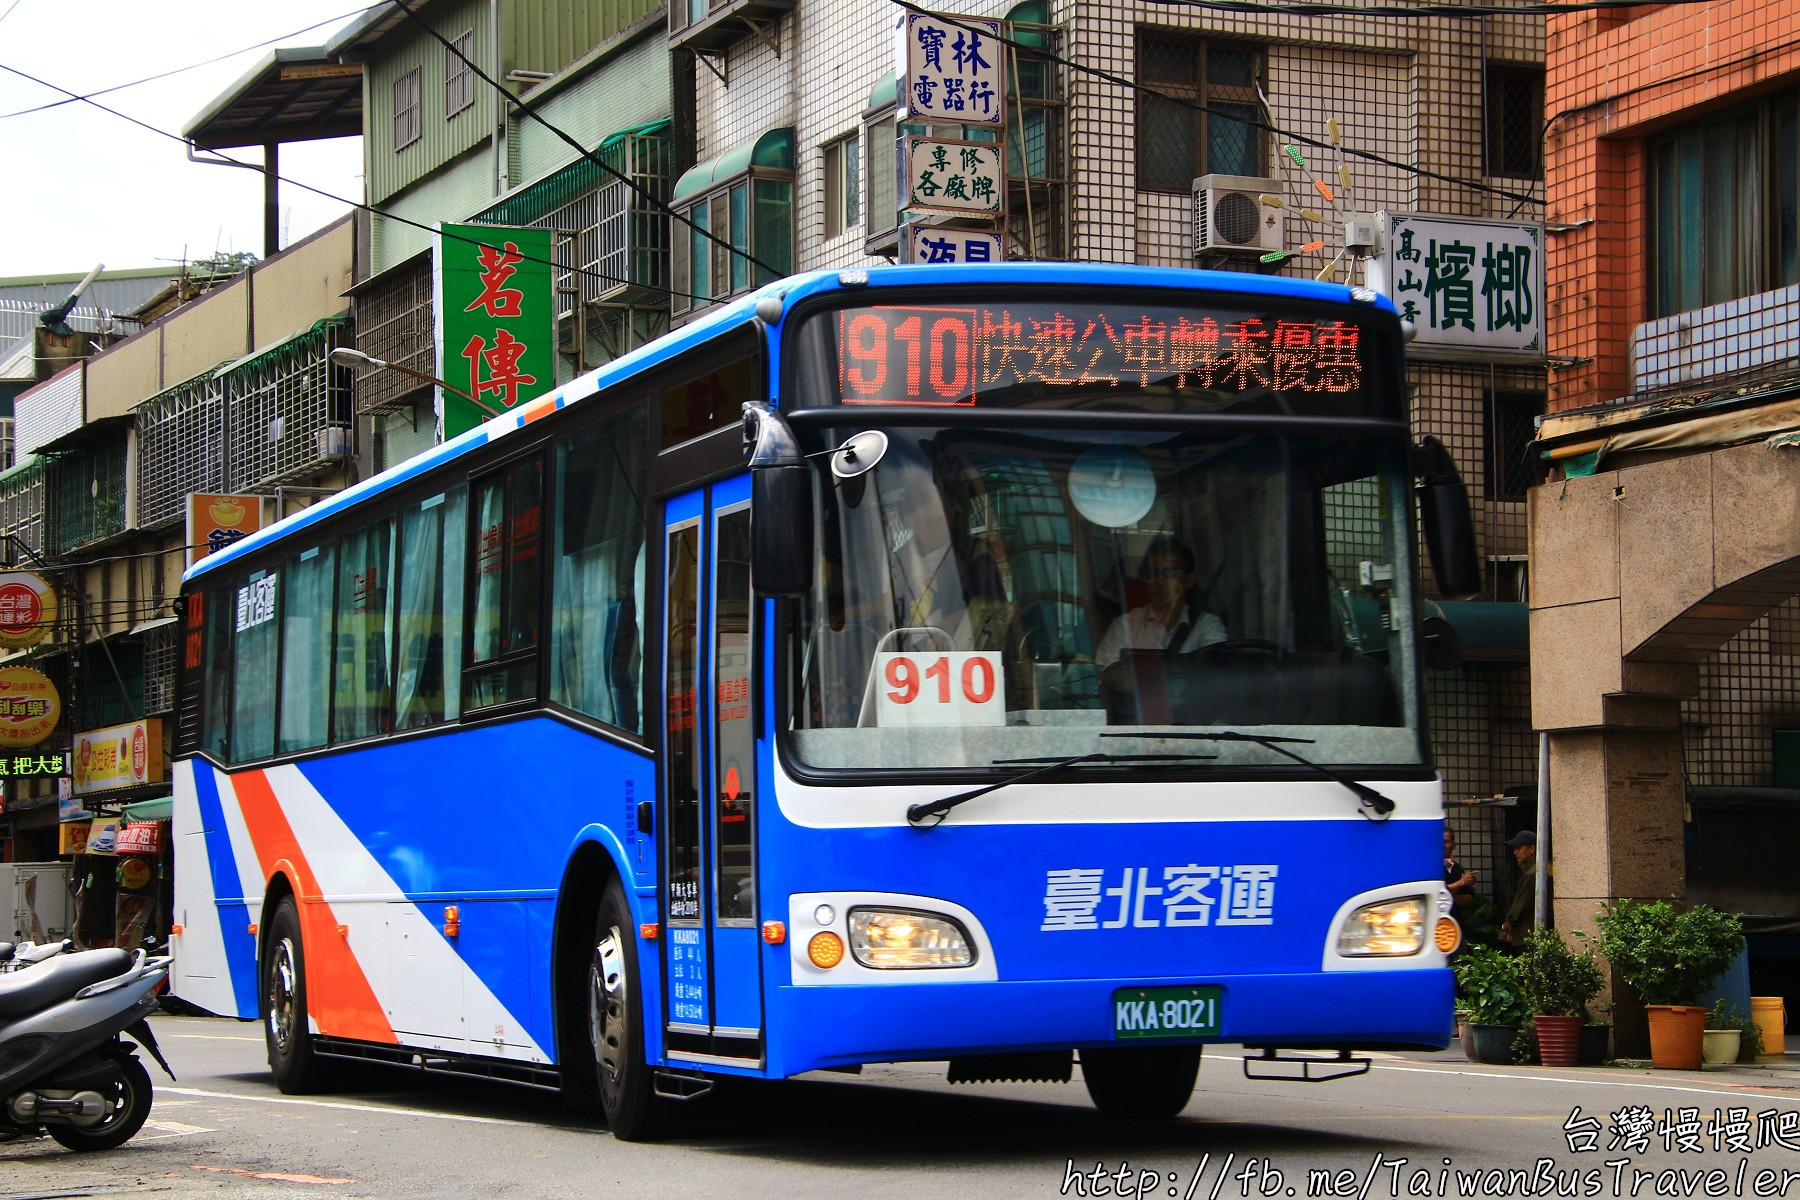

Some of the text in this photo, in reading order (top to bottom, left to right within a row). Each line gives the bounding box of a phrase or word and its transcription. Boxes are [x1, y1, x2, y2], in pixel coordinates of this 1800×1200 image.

[917, 26, 991, 76] 寶林
[914, 75, 995, 114] 電器行
[929, 146, 985, 175] 專修
[916, 170, 996, 204] 各廠牌
[1424, 239, 1533, 332] 檳榔
[461, 241, 537, 420] 茗傳
[847, 314, 970, 397] 910
[976, 310, 1361, 393] 快速公車轉乘優惠
[236, 573, 277, 633] 臺北客運
[885, 656, 995, 704] 910
[1040, 863, 1279, 932] 臺北客運
[673, 929, 699, 944] KKA8021
[1116, 999, 1215, 1031] KKA-8021
